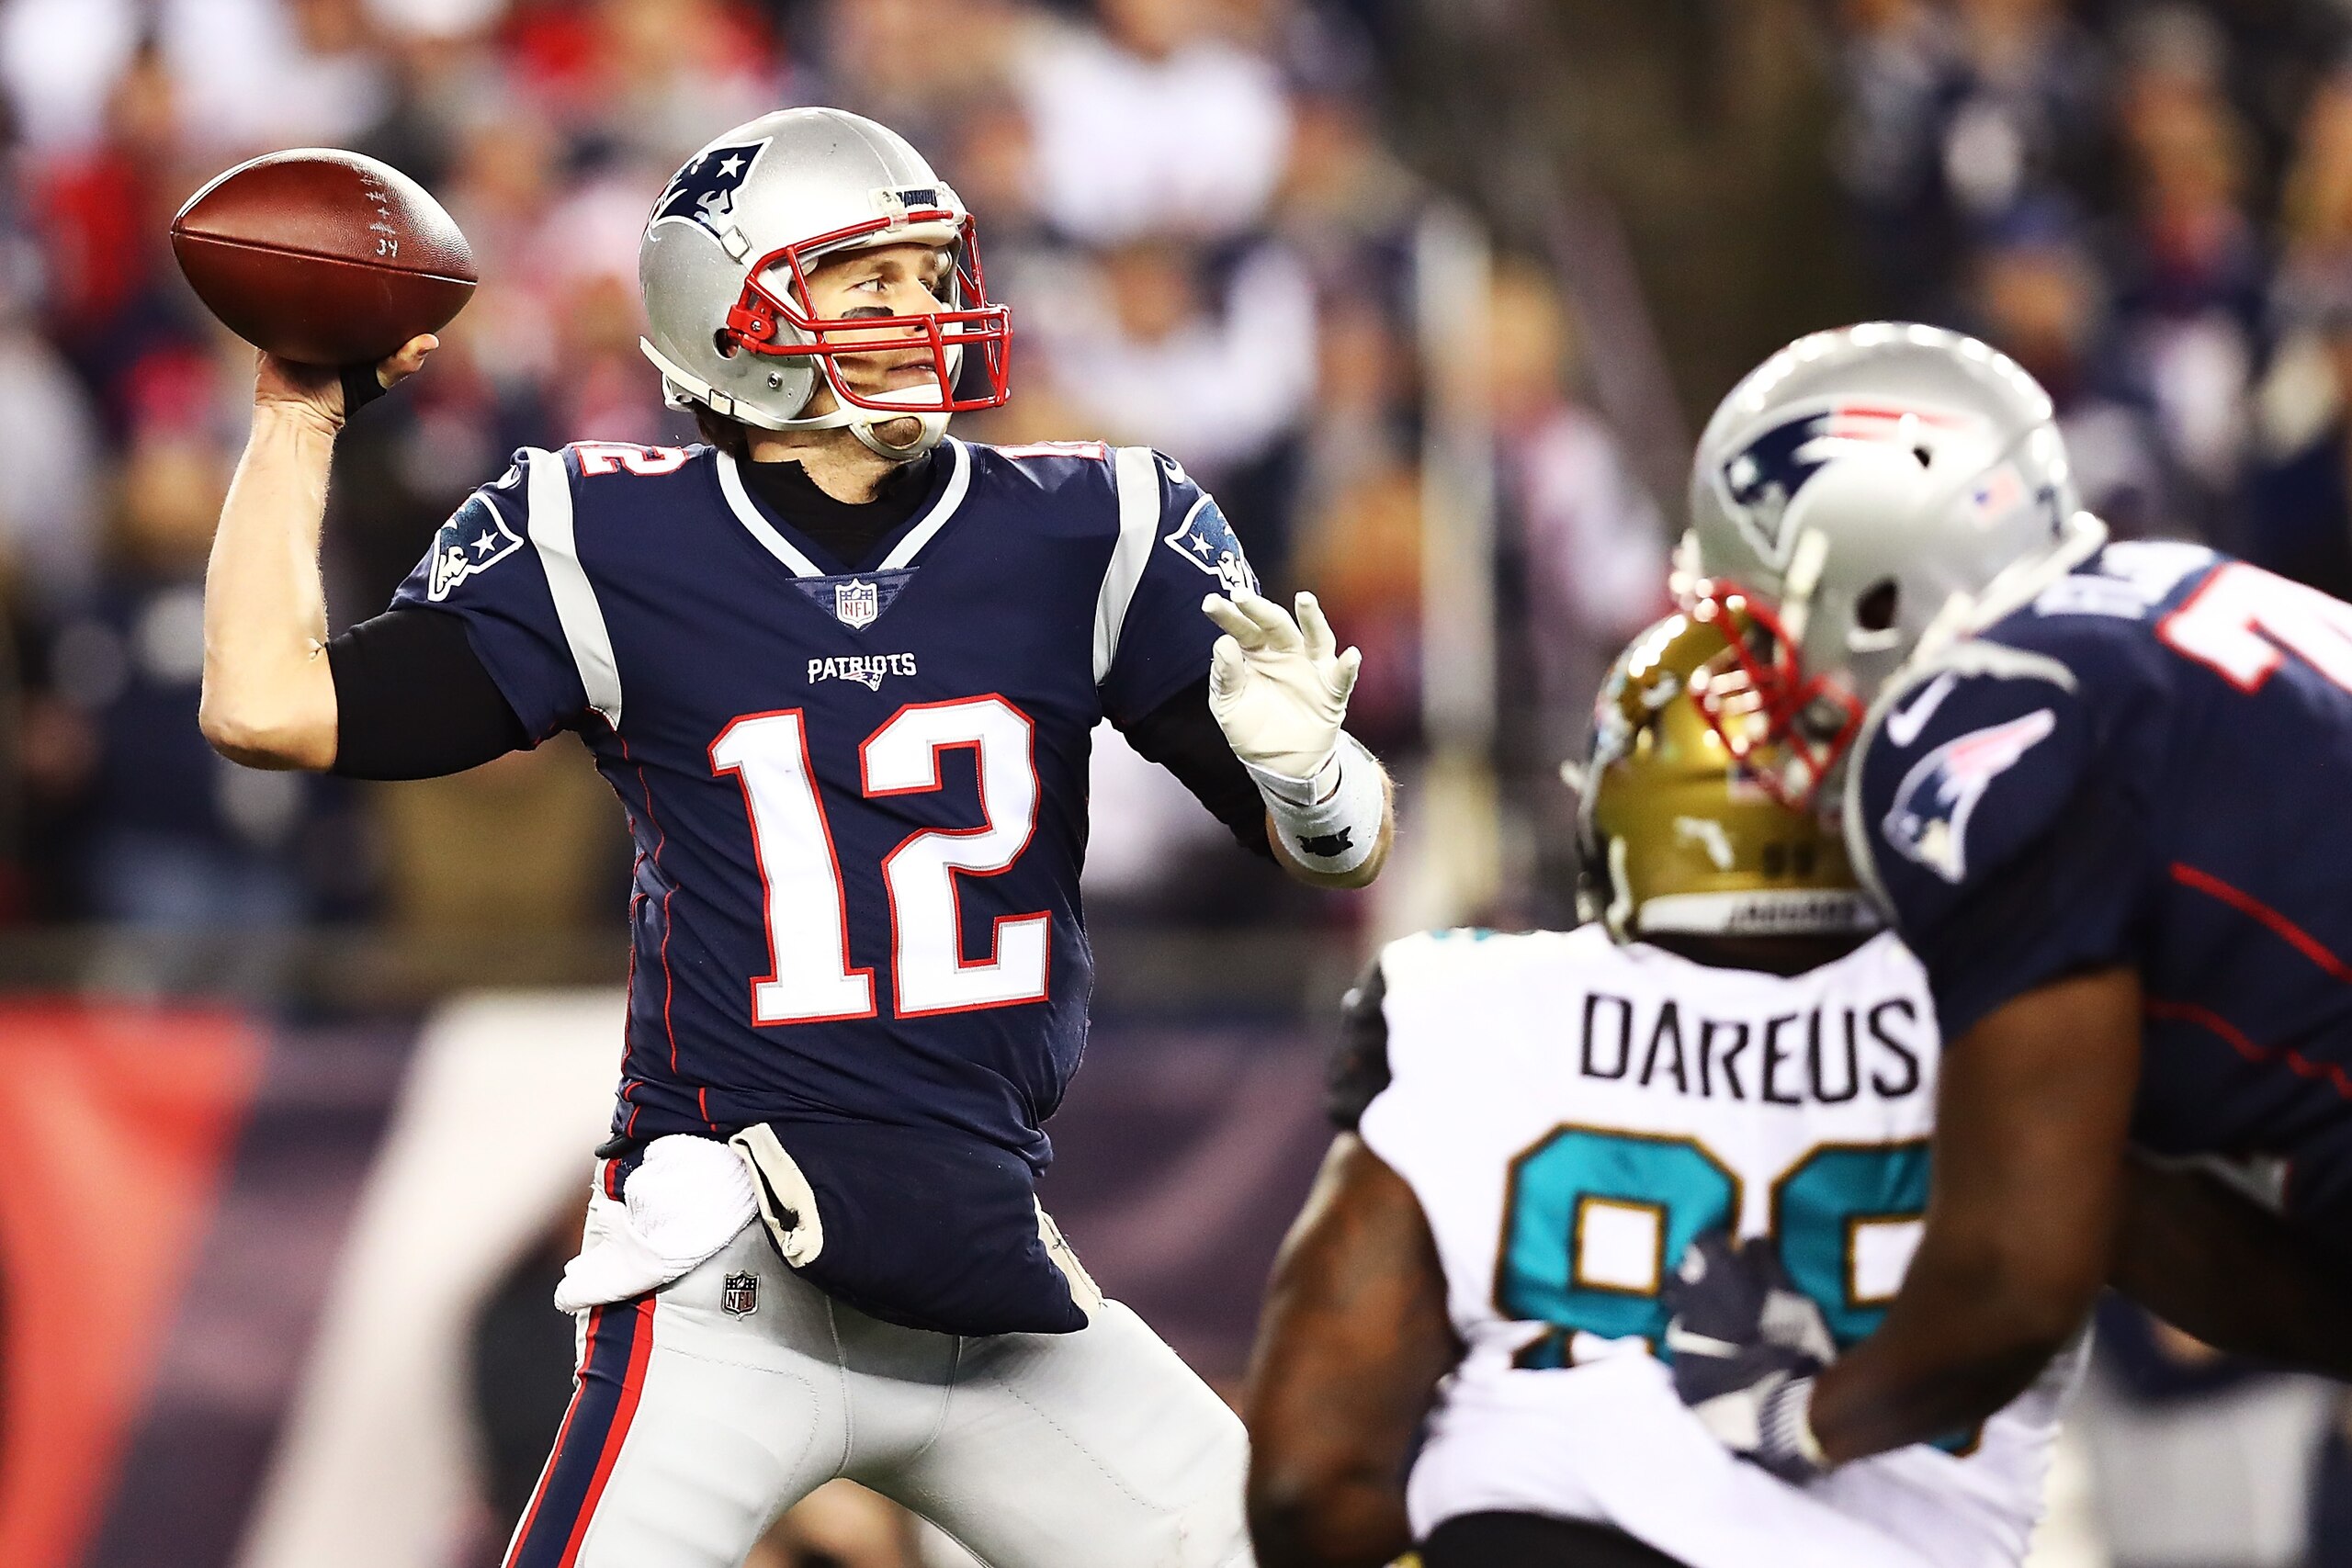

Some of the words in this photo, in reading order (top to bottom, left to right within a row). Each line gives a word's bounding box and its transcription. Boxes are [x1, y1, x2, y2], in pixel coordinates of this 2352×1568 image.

[376, 238, 399, 258] 34
[843, 601, 872, 618] NFL
[807, 652, 917, 685] PATRIOTS
[707, 692, 1052, 1028] 12
[1580, 991, 1921, 1106] DAREUS
[726, 1291, 753, 1310] NFL
